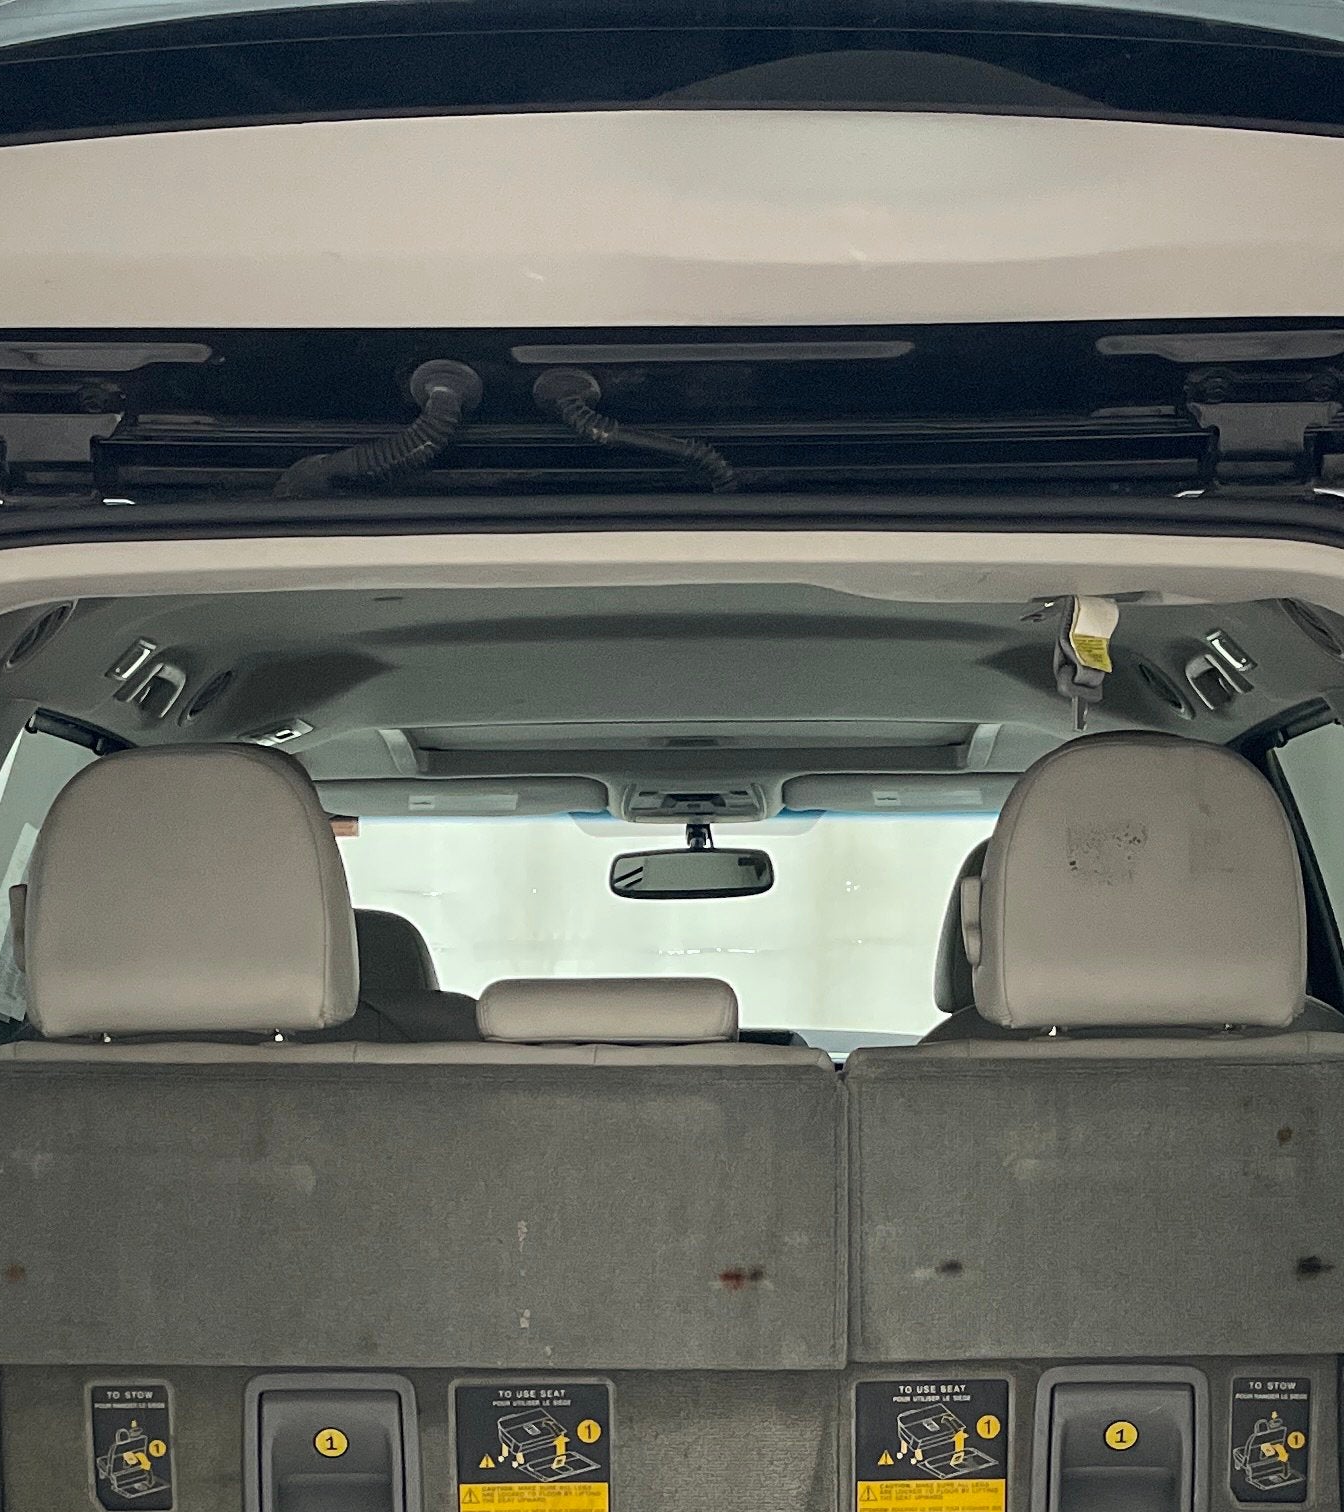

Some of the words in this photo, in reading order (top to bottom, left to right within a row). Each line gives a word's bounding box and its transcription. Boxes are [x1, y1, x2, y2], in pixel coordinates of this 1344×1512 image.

[898, 1386, 912, 1394] TO
[916, 1385, 936, 1393] USE
[940, 1385, 966, 1393] SEAT
[1249, 1382, 1262, 1390] TO
[1267, 1382, 1296, 1390] STOW
[106, 1391, 120, 1399] TO
[124, 1391, 153, 1399] STOW
[498, 1390, 512, 1398] TO
[516, 1390, 536, 1398] USE
[540, 1389, 566, 1398] SEAT
